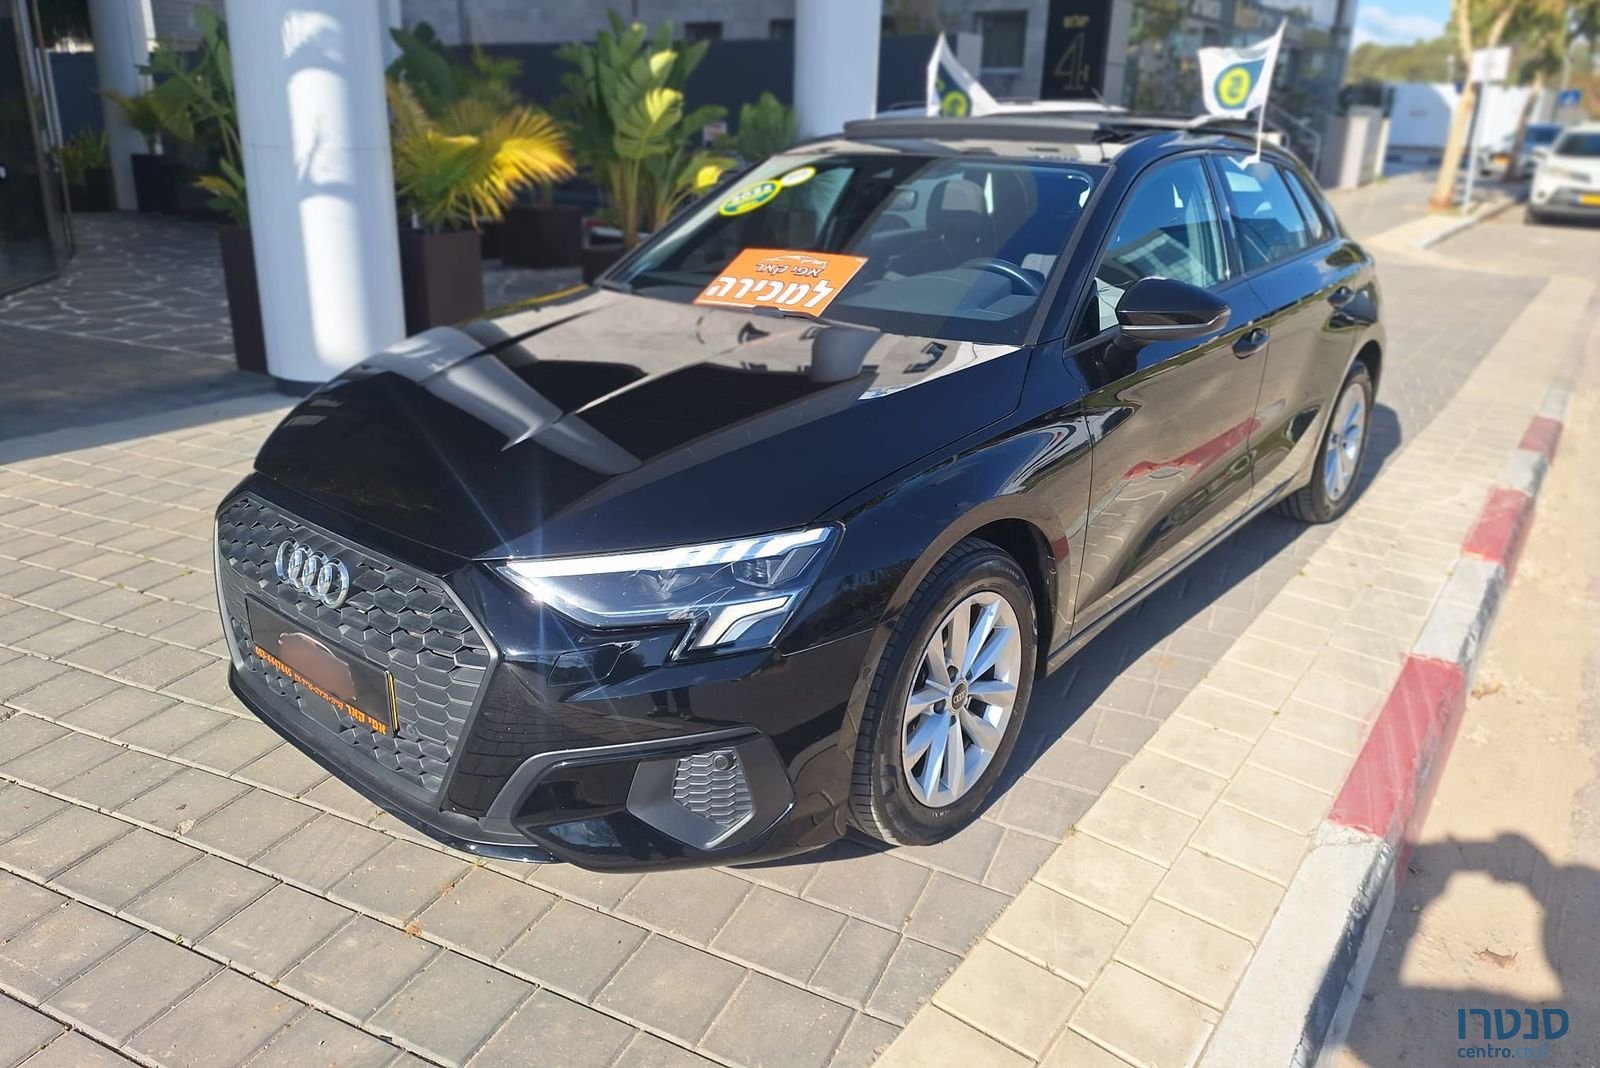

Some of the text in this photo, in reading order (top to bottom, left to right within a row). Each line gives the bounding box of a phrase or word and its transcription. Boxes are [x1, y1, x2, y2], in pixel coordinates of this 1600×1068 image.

[755, 262, 823, 278] אפי קאר
[705, 276, 834, 308] למכירה
[345, 703, 366, 723] קאר
[368, 716, 387, 736] אפי
